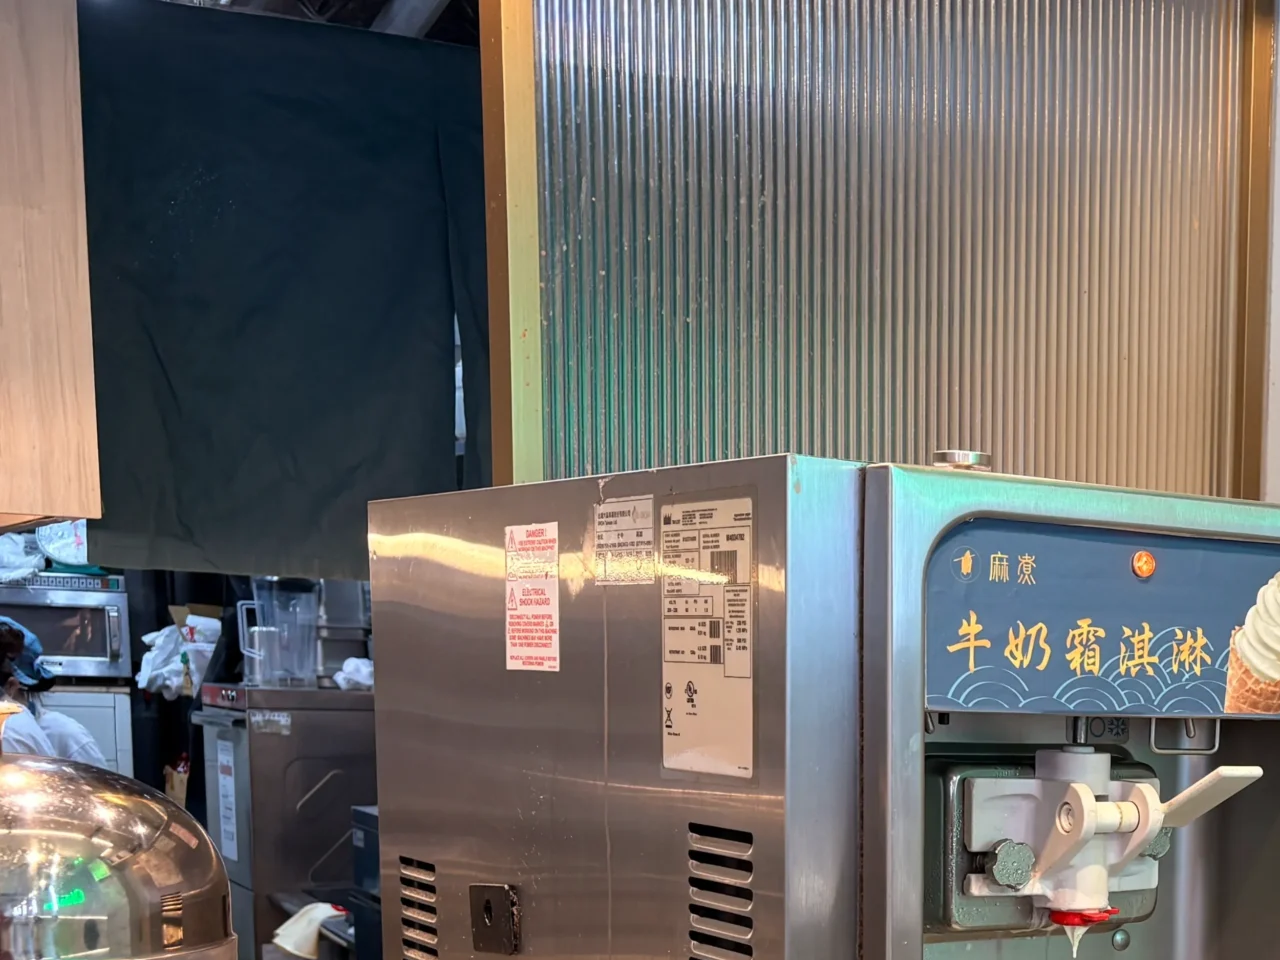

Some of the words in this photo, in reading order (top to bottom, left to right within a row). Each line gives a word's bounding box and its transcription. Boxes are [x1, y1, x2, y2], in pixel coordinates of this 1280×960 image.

[526, 528, 544, 538] DANGER
[946, 611, 1212, 677] 牛奶霜淇淋
